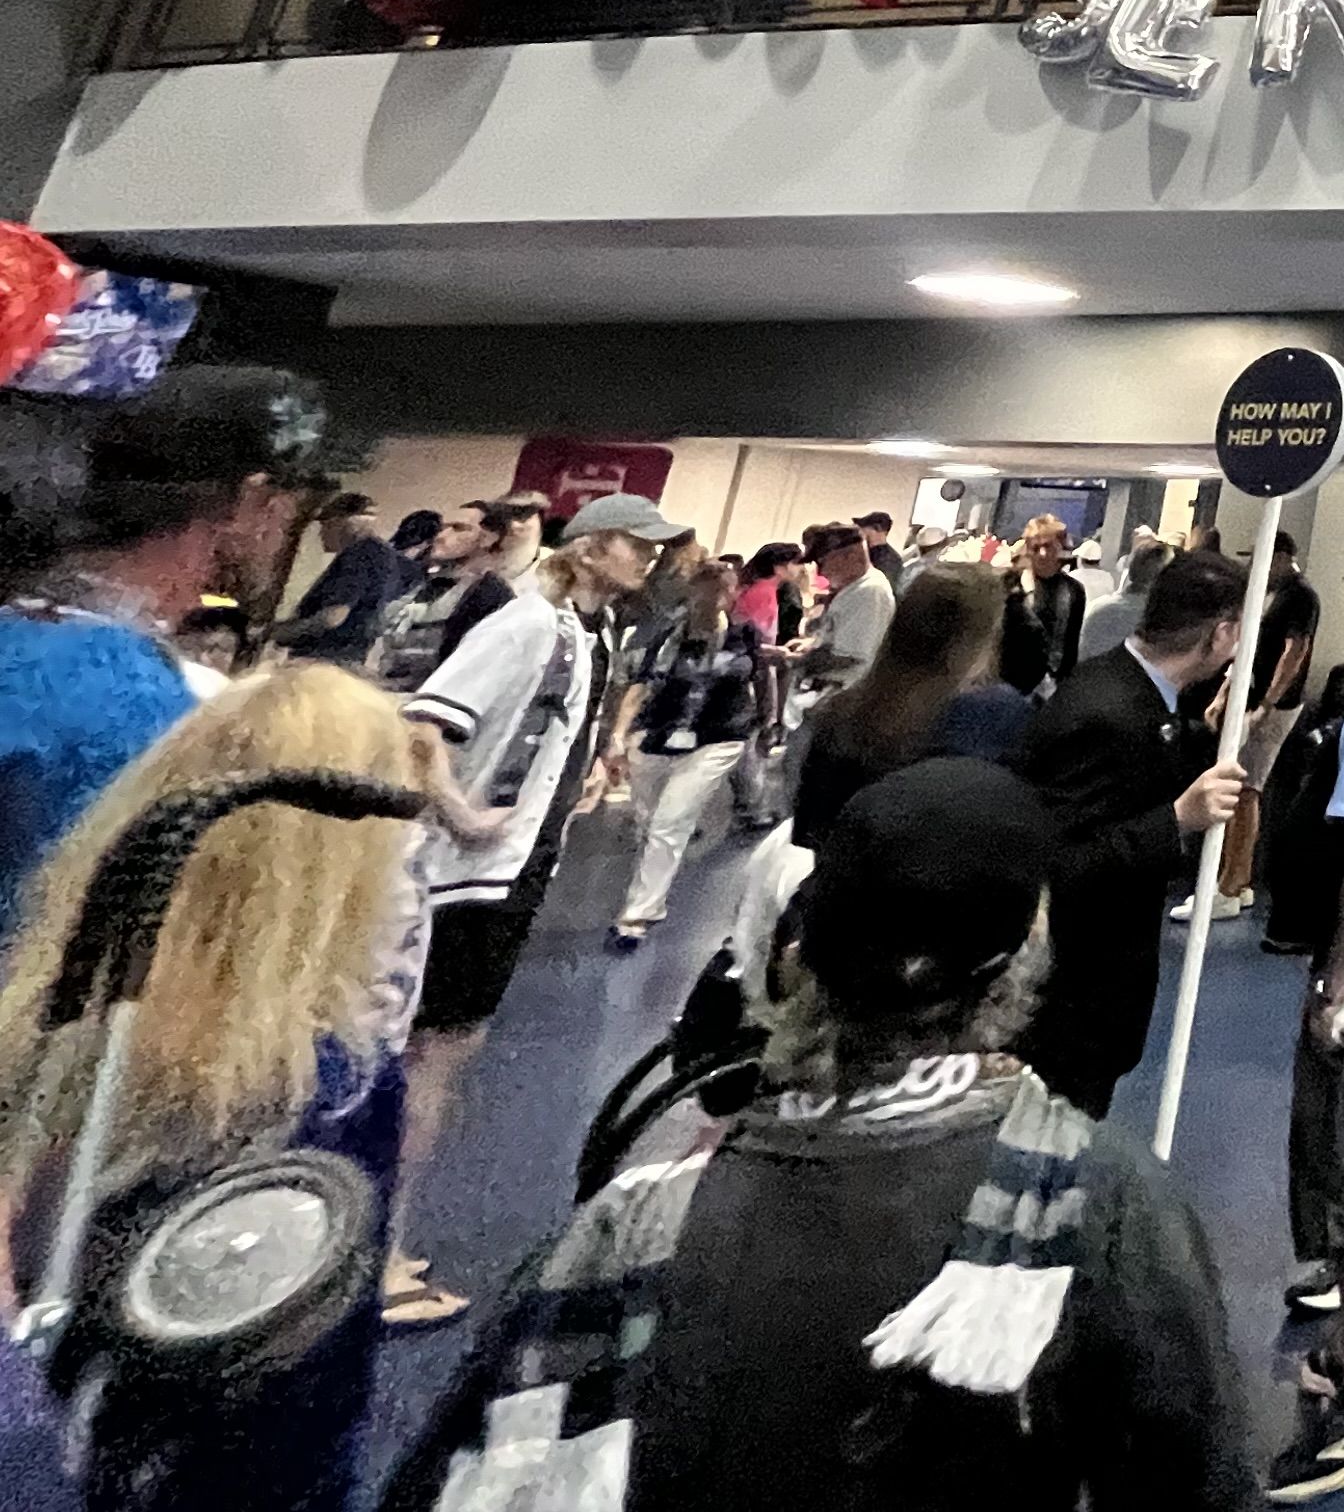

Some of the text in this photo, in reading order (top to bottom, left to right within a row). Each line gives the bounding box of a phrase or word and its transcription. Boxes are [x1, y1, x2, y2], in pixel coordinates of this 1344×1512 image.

[1230, 401, 1333, 420] HOW MAY I
[1226, 427, 1327, 446] HELP YOU?
